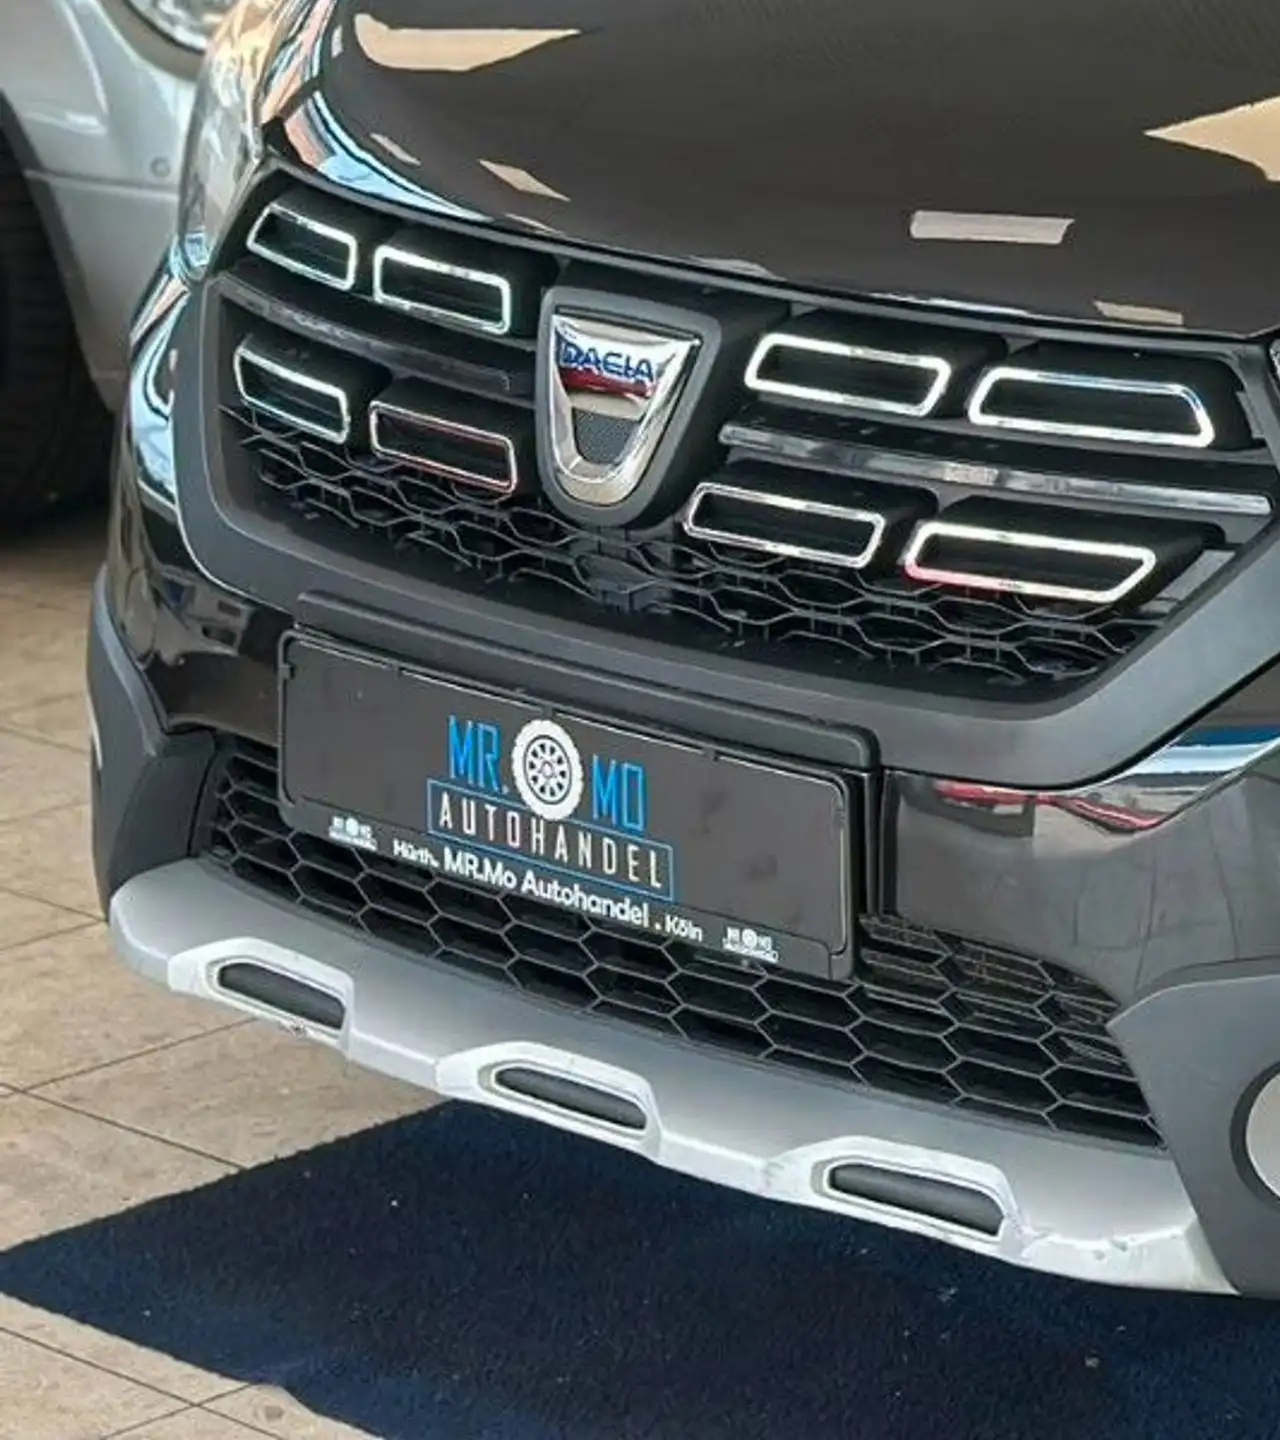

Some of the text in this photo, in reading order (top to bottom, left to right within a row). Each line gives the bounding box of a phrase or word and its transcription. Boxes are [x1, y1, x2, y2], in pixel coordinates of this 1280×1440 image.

[559, 341, 655, 383] DACIA
[448, 715, 645, 832] MR. MO
[438, 791, 662, 889] AUTOHANDEL
[520, 869, 650, 928] Autohandel
[664, 914, 703, 942] Köln
